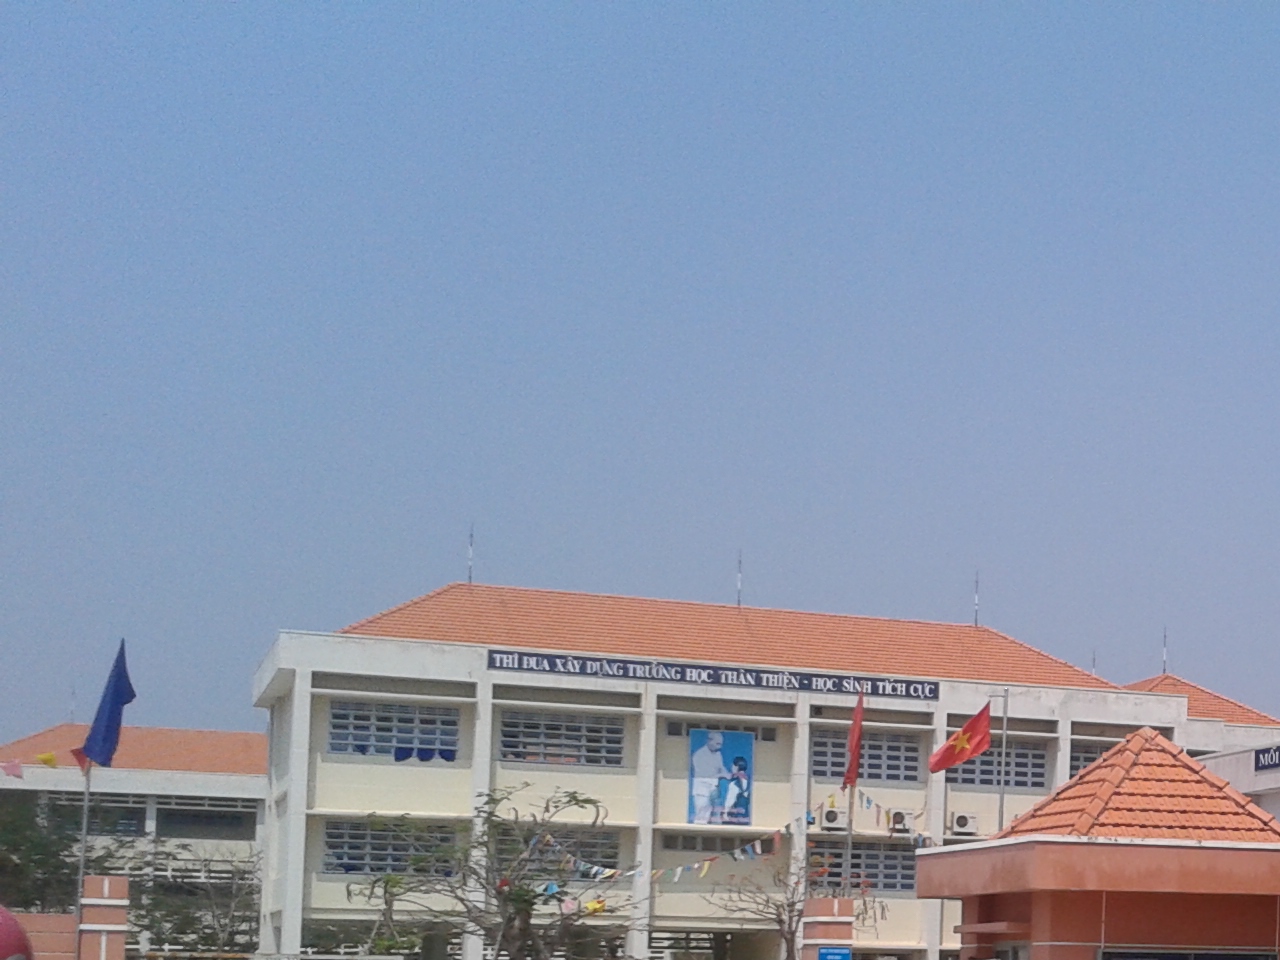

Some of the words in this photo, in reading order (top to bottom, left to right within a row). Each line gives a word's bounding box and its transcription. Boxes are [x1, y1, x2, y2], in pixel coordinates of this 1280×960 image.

[522, 656, 550, 671] ĐUA
[554, 657, 583, 673] XÂY
[586, 660, 624, 677] DỰNG
[627, 660, 681, 680] TRƯỜNG
[685, 669, 714, 684] HỌC
[718, 669, 756, 686] THÂN
[760, 672, 800, 690] THIỆN
[812, 677, 839, 693] HỌC
[910, 683, 935, 699] CỰC
